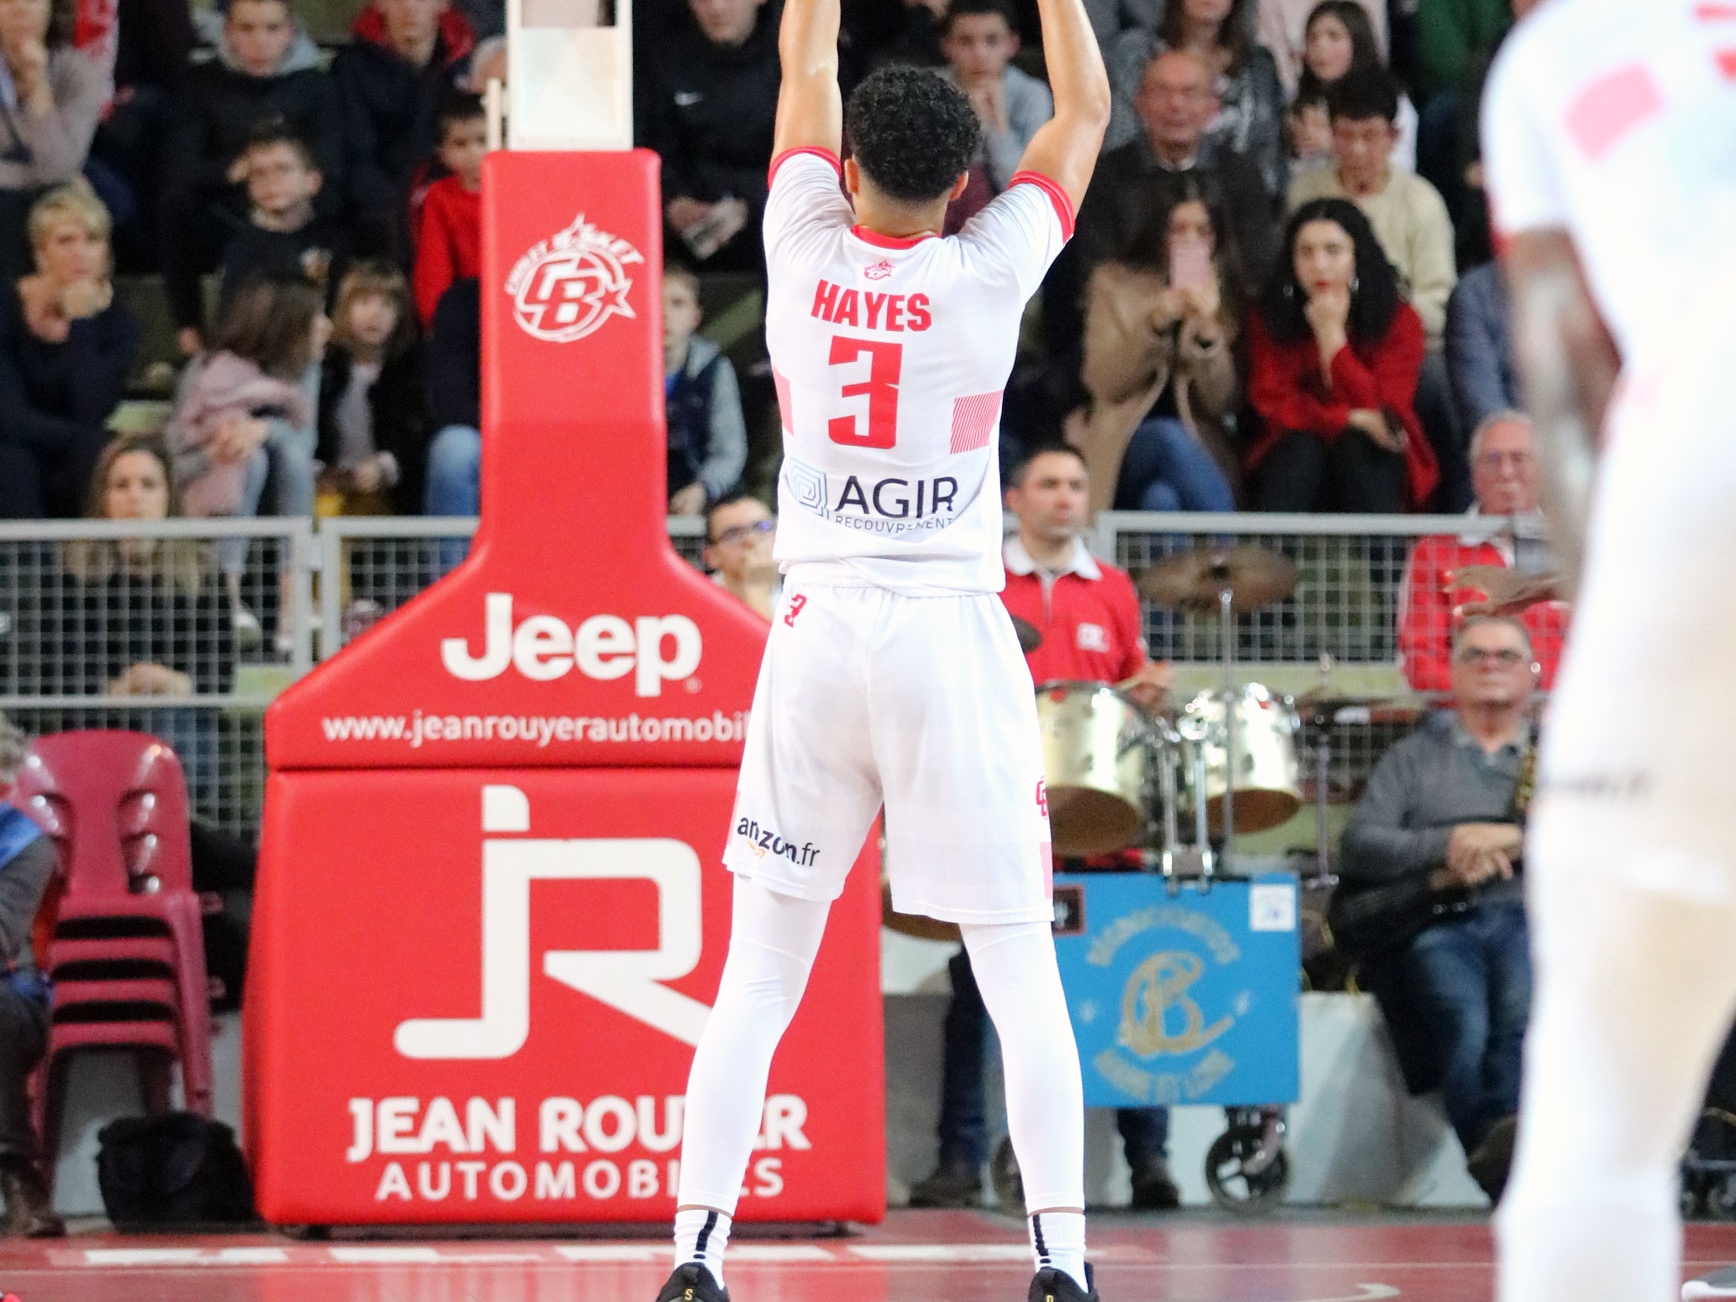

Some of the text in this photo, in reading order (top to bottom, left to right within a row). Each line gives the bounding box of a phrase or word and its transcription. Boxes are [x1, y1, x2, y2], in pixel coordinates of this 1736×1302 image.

[811, 279, 932, 332] HAYES
[828, 335, 903, 449] 3
[834, 475, 959, 519] AGIR
[440, 593, 703, 697] Jeep
[345, 1094, 812, 1163] JEAN ROUR
[376, 1157, 785, 1201] AUTOMOBIS
